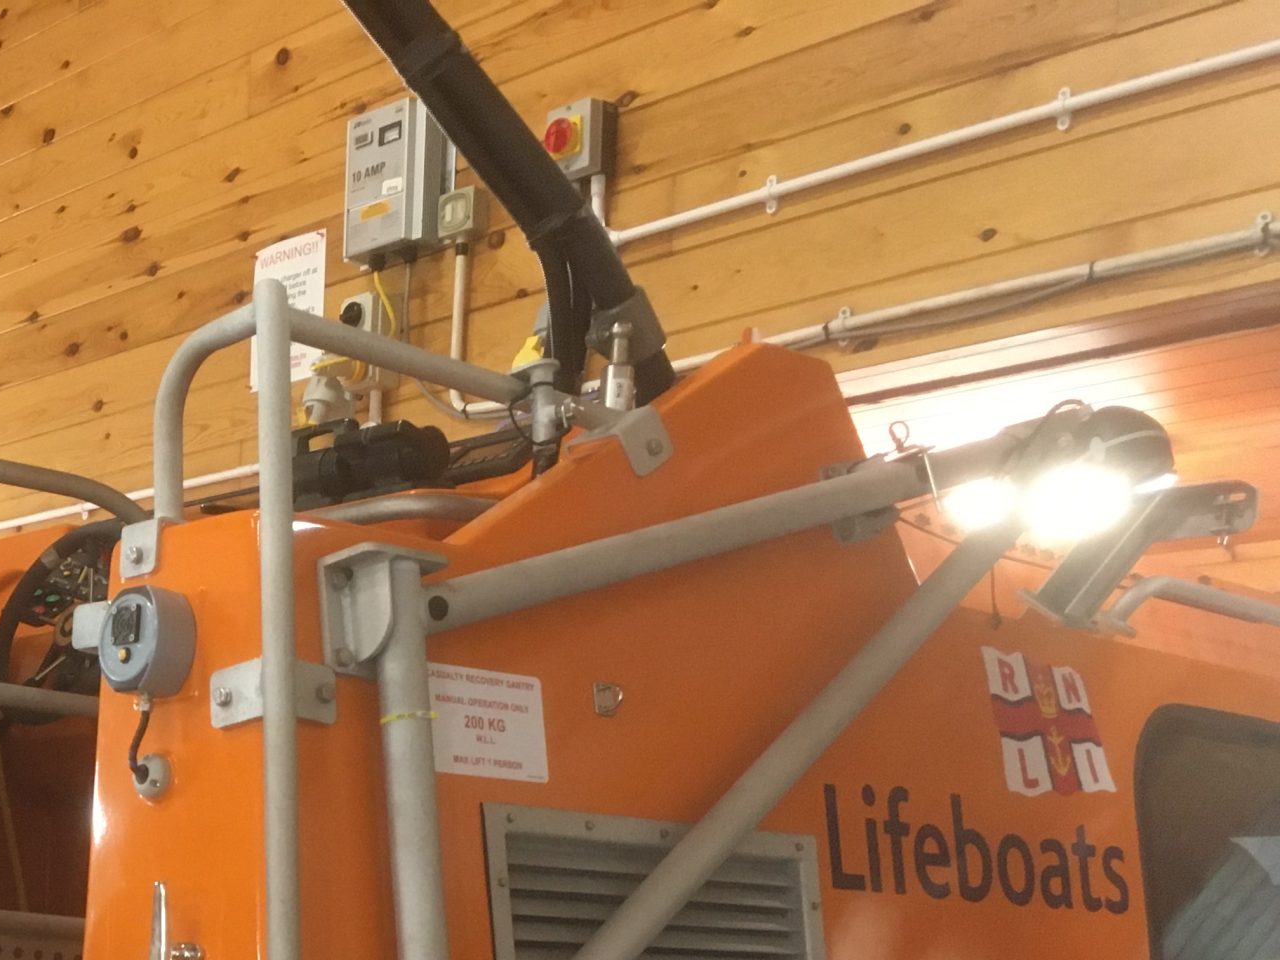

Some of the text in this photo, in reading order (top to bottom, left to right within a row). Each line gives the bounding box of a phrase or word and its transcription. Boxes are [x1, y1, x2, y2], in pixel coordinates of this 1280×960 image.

[351, 161, 386, 183] 10 AMP
[260, 241, 318, 270] WARNING!!
[465, 673, 504, 687] RECOVERY
[506, 680, 534, 692] GANTRY
[997, 657, 1081, 704] R N
[434, 693, 466, 706] MANUAL
[467, 697, 509, 711] OPERATION
[464, 714, 507, 733] 200 KG
[452, 755, 469, 765] MAX
[494, 758, 523, 771] PERSON
[1017, 748, 1040, 789] L
[823, 783, 1130, 915] Lifeboats
